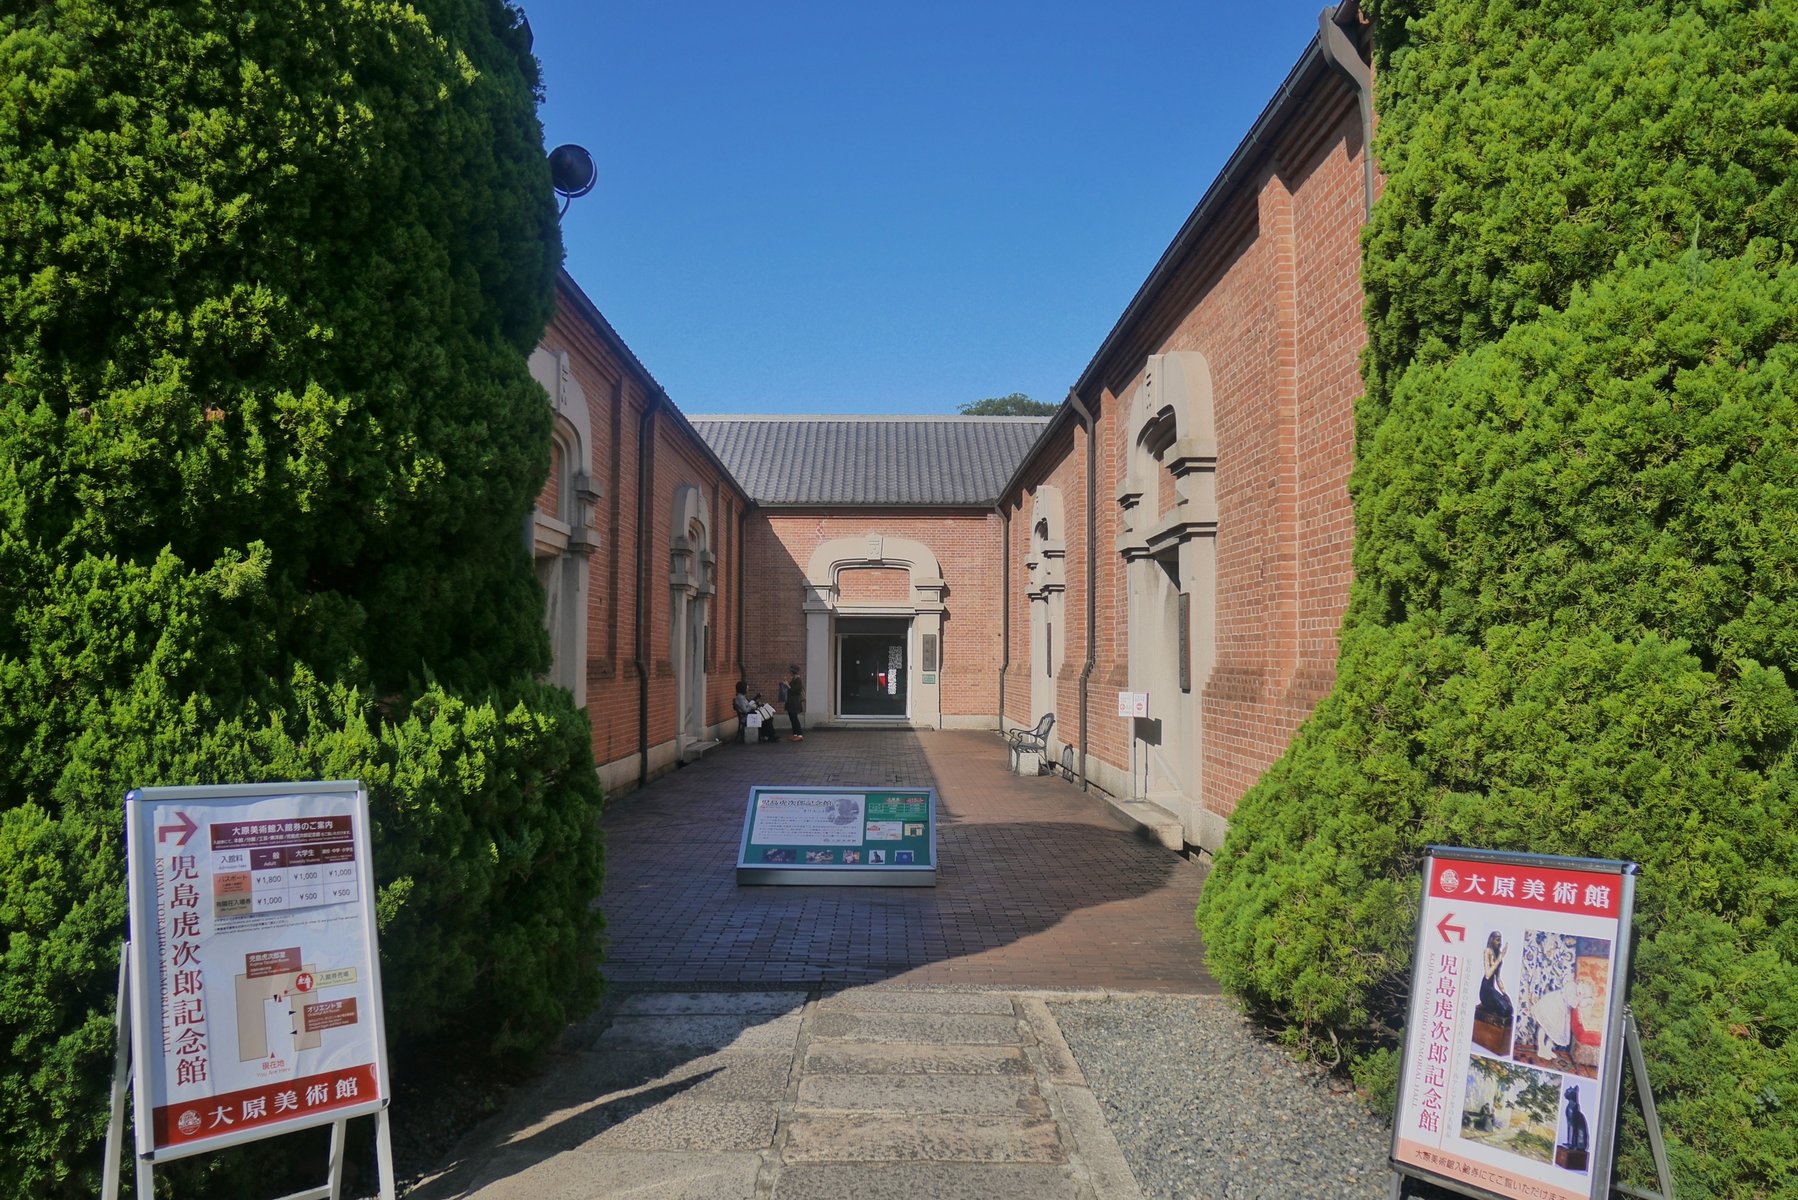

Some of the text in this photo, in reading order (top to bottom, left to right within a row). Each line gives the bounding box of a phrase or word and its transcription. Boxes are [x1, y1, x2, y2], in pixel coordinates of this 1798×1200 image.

[232, 821, 333, 836] 大原美術館入館券のご案内
[1464, 873, 1611, 909] 大原美術館
[154, 858, 171, 1056] KOJIMA TORAJIRO MEMORIAL HALL
[170, 855, 208, 1086] 児島虎次郎記念館
[262, 1060, 285, 1070] 現在地
[1412, 952, 1435, 1109] KOJIMA TORAJIRO MEMORIAL HALL
[1418, 954, 1458, 1133] 児島虎次郎記念館
[208, 1076, 358, 1129] 大原美術館
